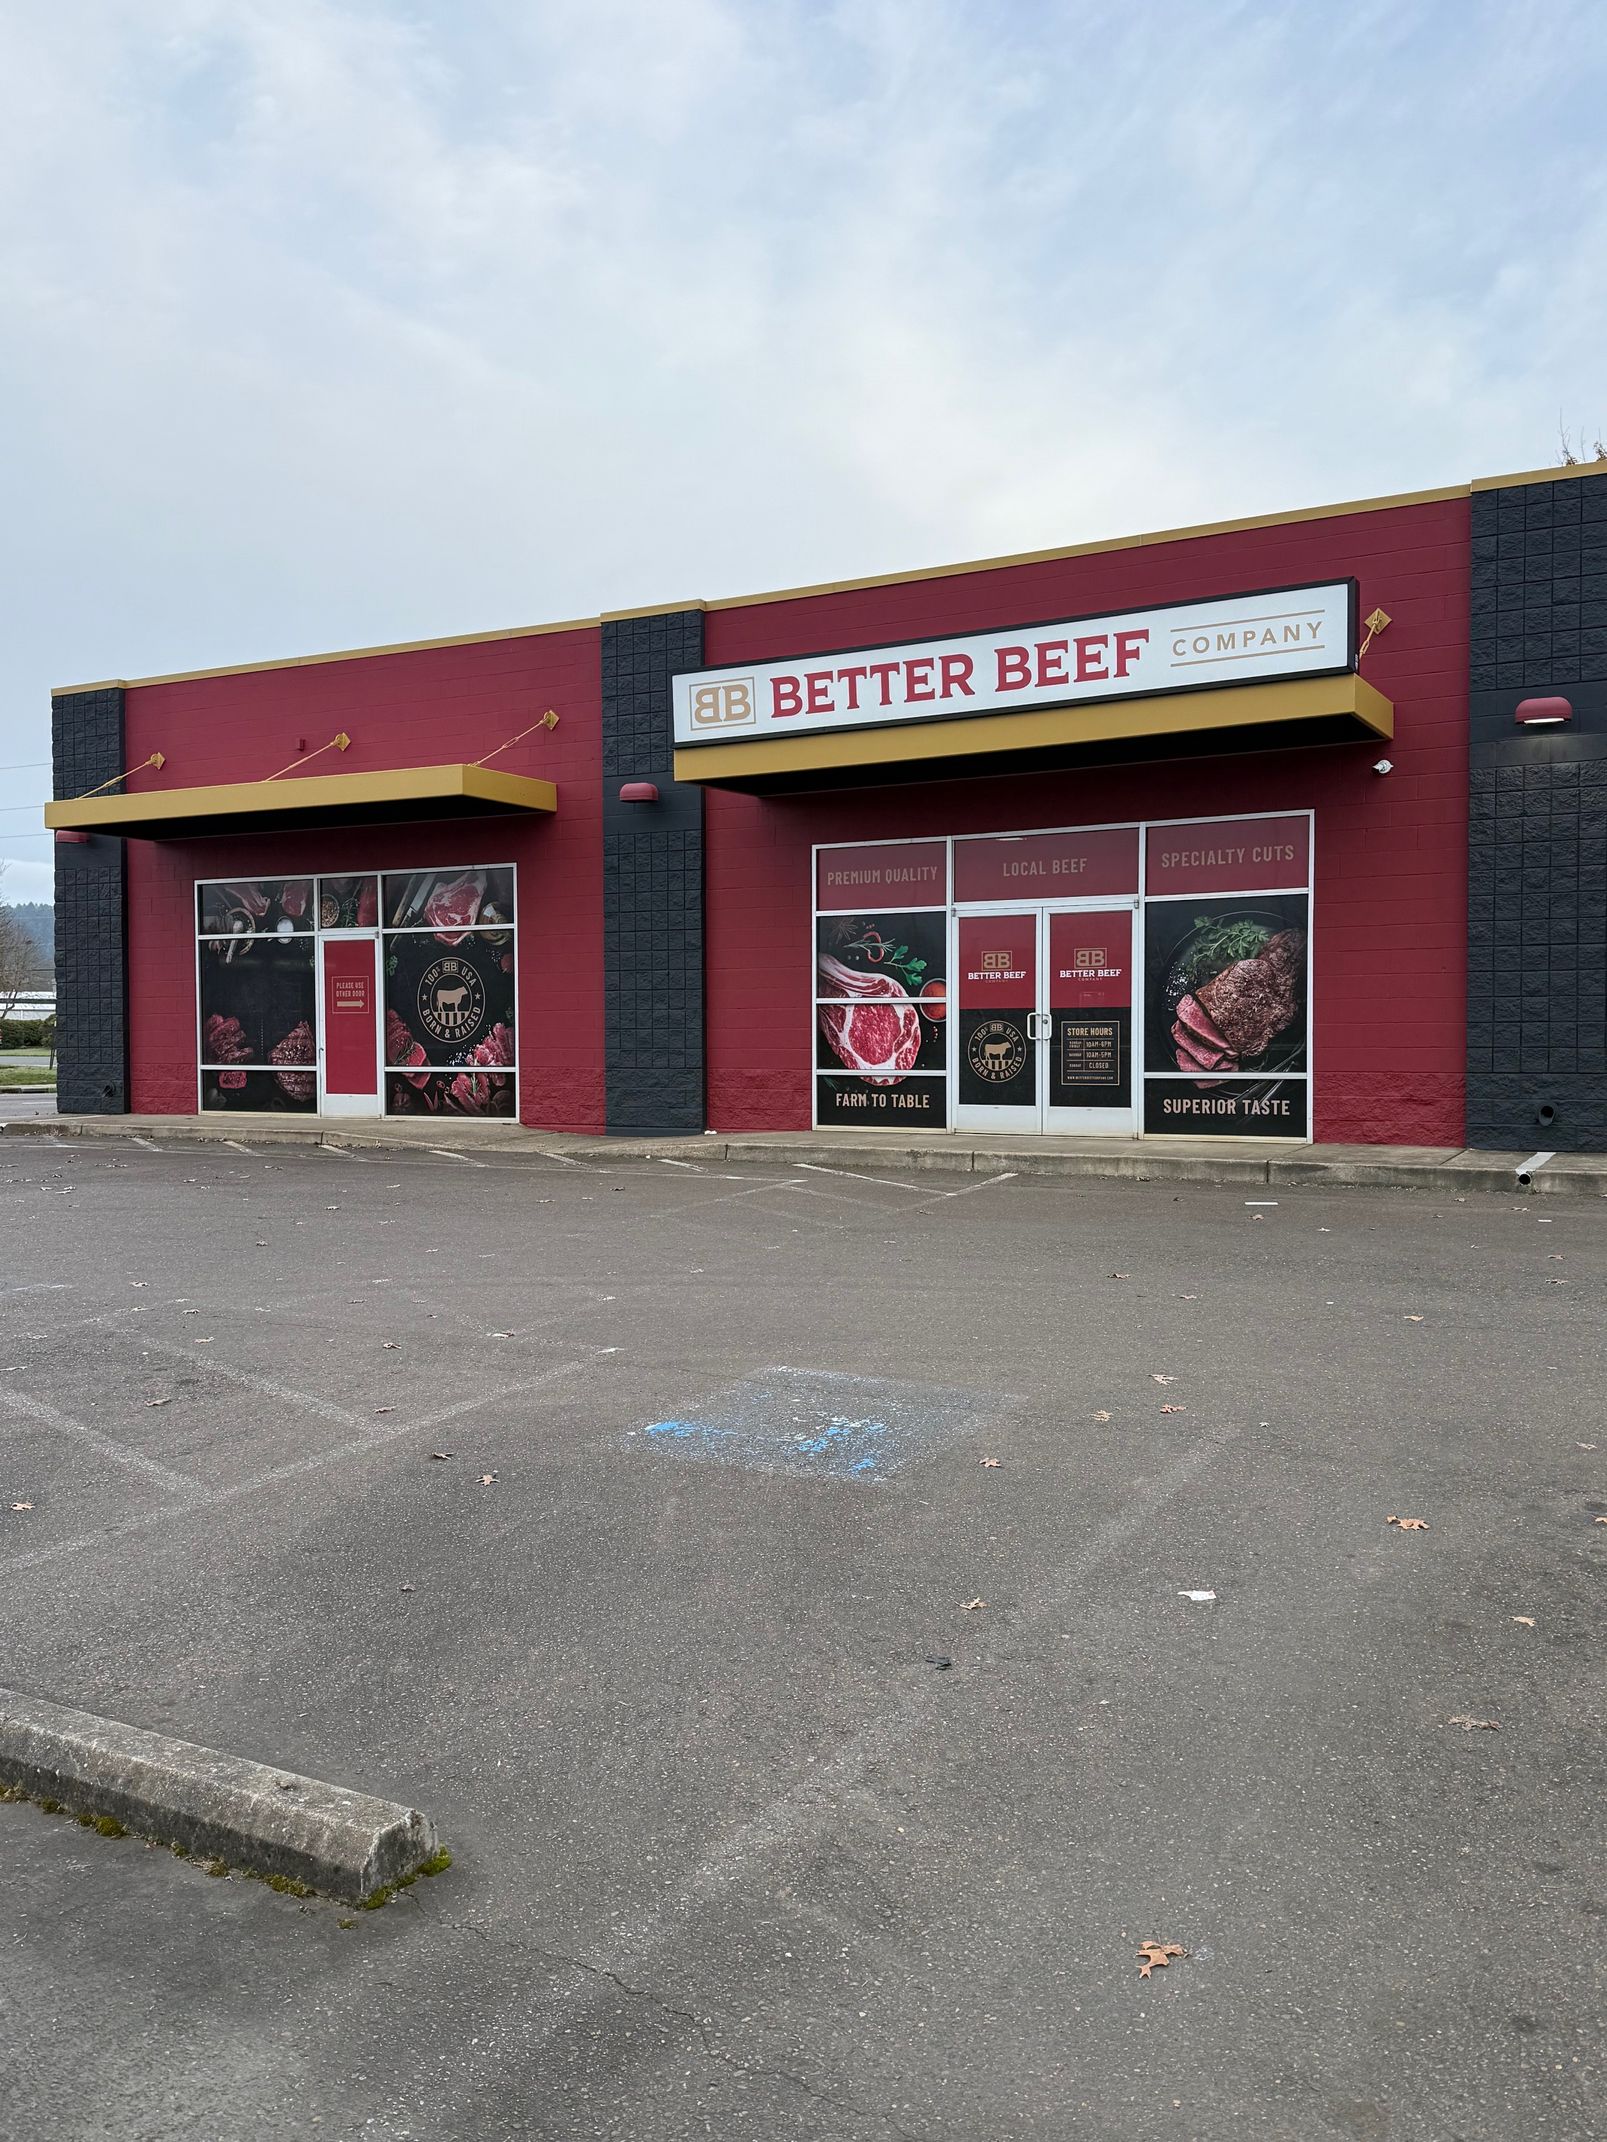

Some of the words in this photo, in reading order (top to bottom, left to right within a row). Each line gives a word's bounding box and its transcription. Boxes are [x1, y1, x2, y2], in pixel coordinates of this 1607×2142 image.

[769, 653, 975, 718] BETTER
[994, 628, 1150, 692] BEEF
[1172, 621, 1323, 657] COMPANY
[1161, 847, 1246, 868] SPECIALTY
[1252, 845, 1294, 862] CUTS
[827, 869, 880, 886] PREMIUM
[885, 866, 938, 884] QUALITY
[1003, 860, 1047, 877] LOCAL
[1052, 858, 1088, 874] BEEF
[461, 966, 477, 986] USA
[968, 972, 1001, 980] BETTER
[1003, 971, 1027, 979] BEEF
[1060, 970, 1095, 978] BETTER
[1097, 969, 1122, 977] BEEF
[422, 1008, 442, 1035] BORN
[444, 1029, 451, 1038] &
[454, 1006, 481, 1038] RAISED
[1067, 1027, 1089, 1036] STORE
[1090, 1027, 1113, 1036] HOURS
[1005, 1027, 1019, 1042] USA
[972, 1057, 989, 1077] BORN
[999, 1056, 1022, 1079] RAISED
[836, 1093, 867, 1107] FARM
[871, 1094, 887, 1107] TO
[891, 1094, 930, 1108] TABLE
[1163, 1098, 1236, 1114] SUPERIOR
[1242, 1099, 1290, 1115] TASTE
